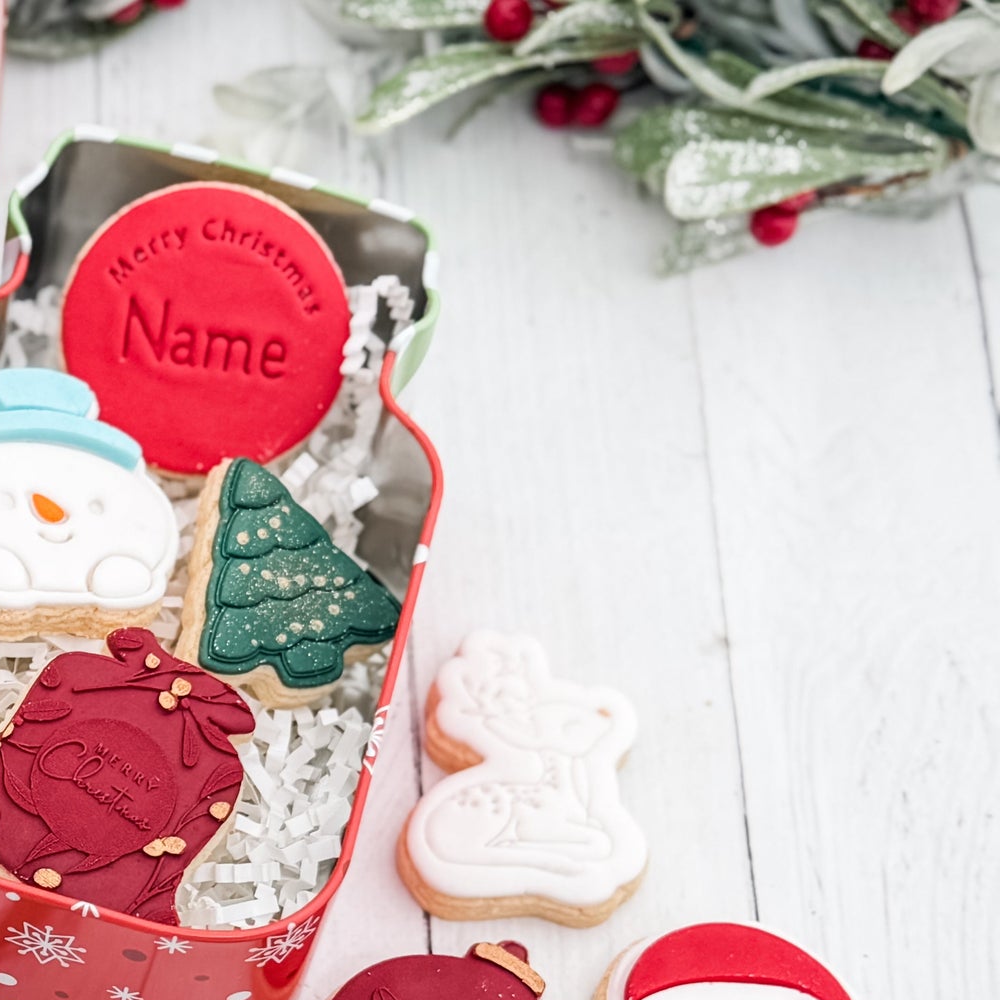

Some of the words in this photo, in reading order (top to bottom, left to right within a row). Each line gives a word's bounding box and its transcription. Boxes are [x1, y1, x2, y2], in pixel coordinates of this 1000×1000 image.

[108, 226, 188, 285] Merry
[201, 218, 322, 316] Christmas
[121, 293, 287, 380] Name
[94, 742, 161, 792] MERRY
